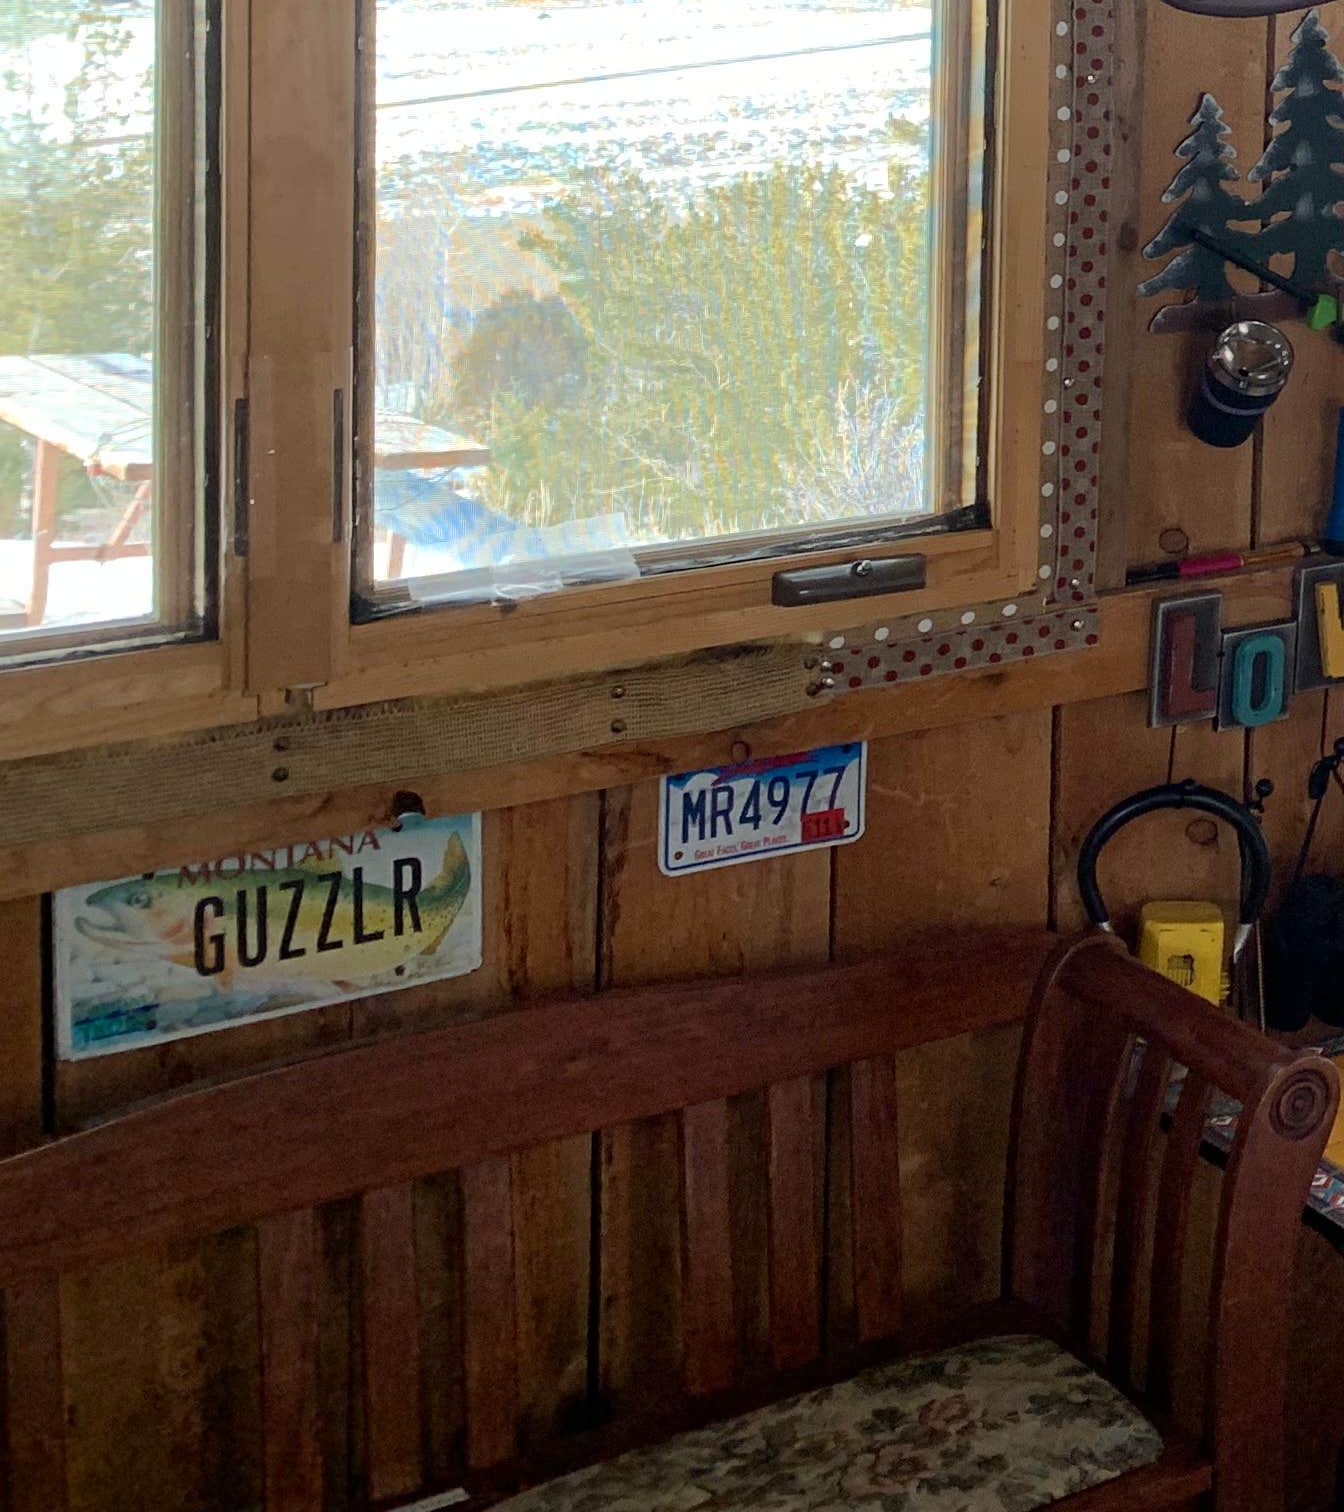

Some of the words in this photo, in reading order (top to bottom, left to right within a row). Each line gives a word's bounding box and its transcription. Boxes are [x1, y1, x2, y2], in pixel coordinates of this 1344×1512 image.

[681, 765, 848, 844] MR4977
[177, 828, 382, 888] MONTANA
[193, 856, 423, 977] GUZZLR
